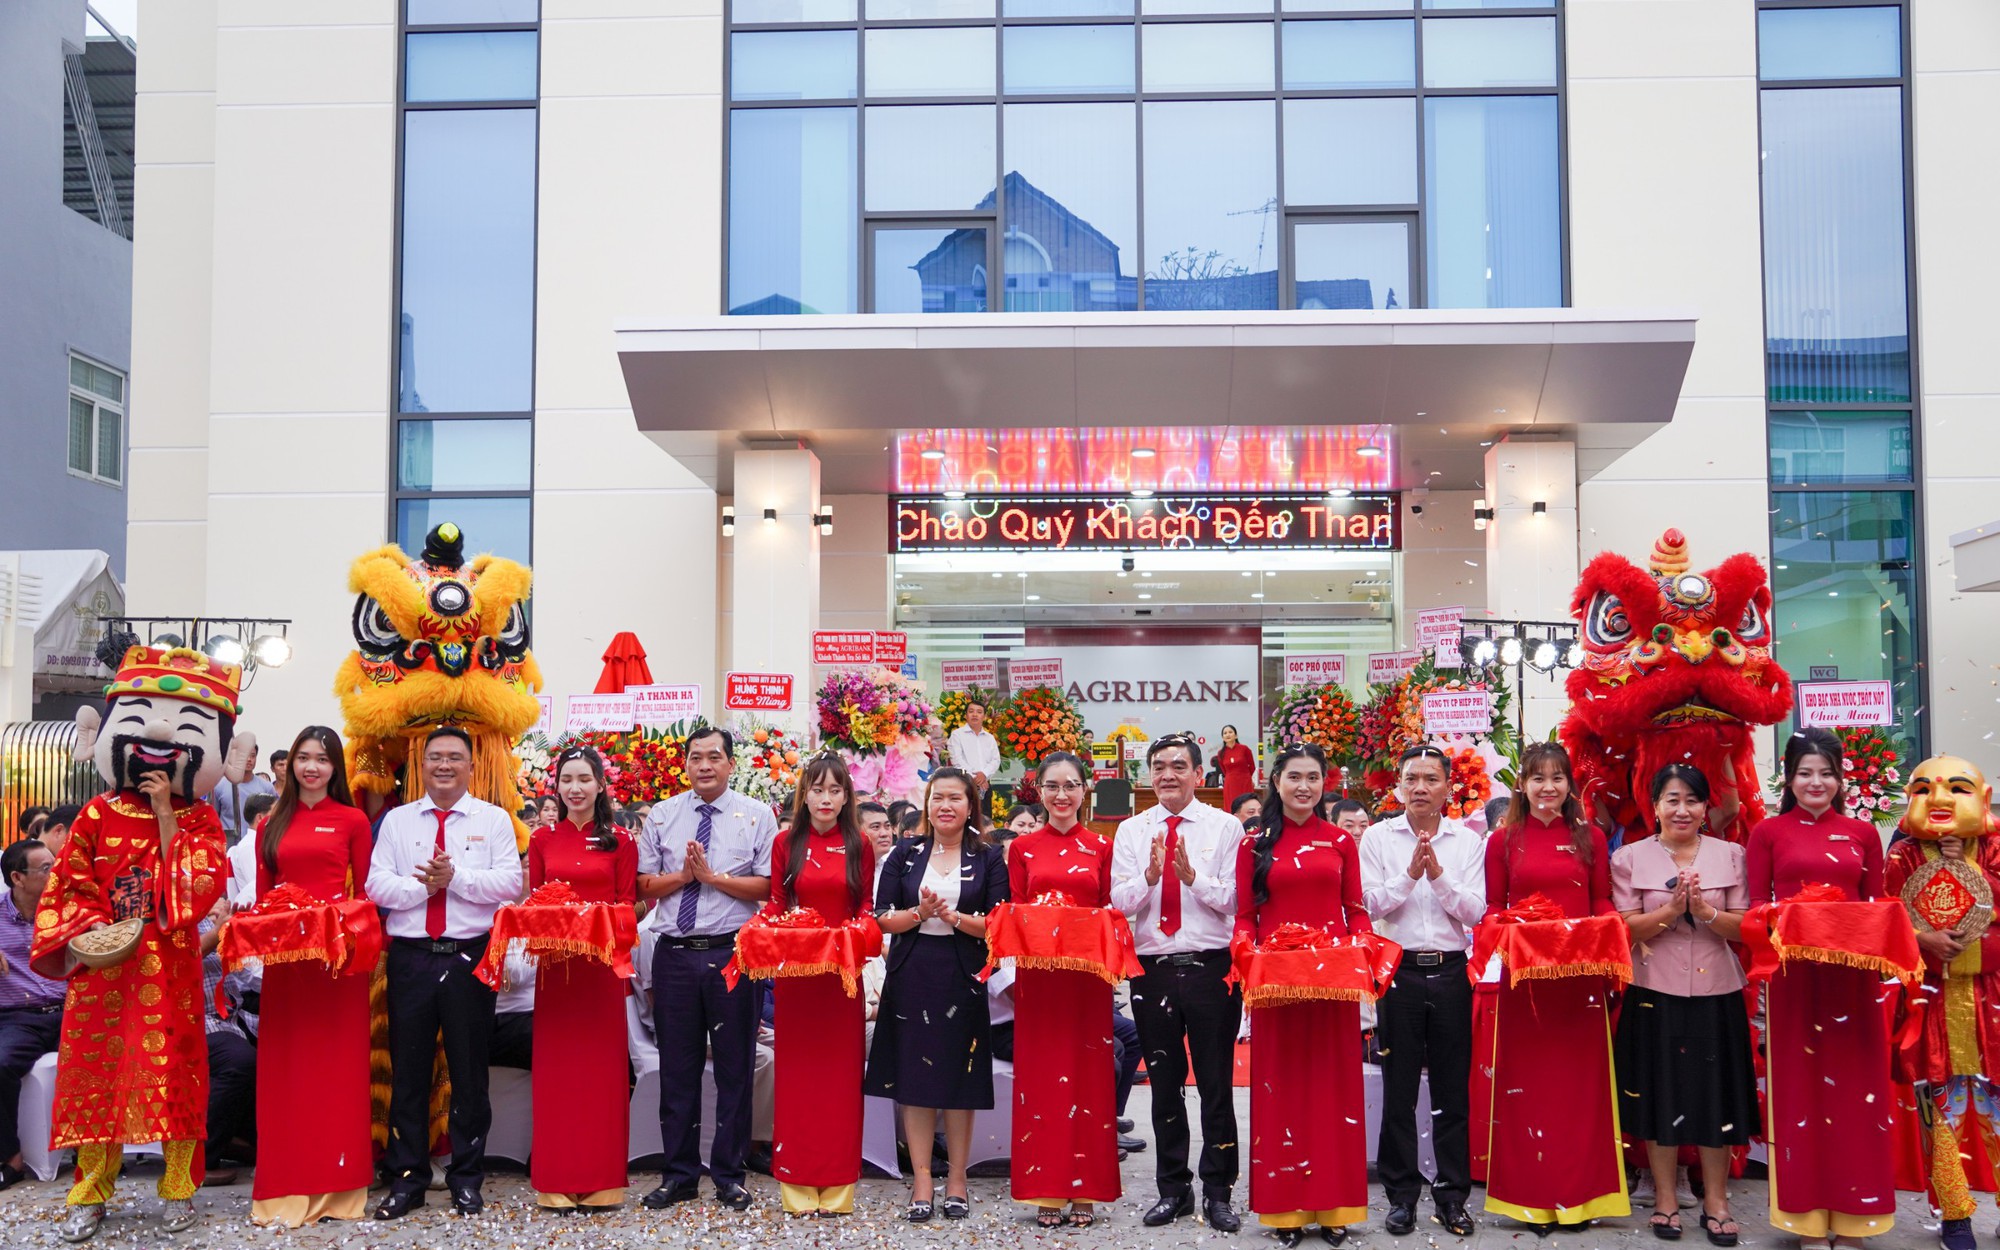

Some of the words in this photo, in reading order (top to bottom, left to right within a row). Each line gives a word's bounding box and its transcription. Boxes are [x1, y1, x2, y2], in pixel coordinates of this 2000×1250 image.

[1000, 508, 1075, 549] Quý
[1087, 508, 1200, 541] Khách
[1212, 500, 1287, 540] Đến
[840, 644, 872, 652] AGRIBANK
[1305, 658, 1320, 672] PHỐ
[1813, 668, 1835, 677] WC
[647, 691, 678, 701] THANH
[681, 688, 694, 700] HÀ
[760, 685, 784, 697] THỊNH
[1065, 680, 1250, 703] AGRIBANK
[730, 695, 754, 705] Chúc
[756, 696, 787, 709] Mừng
[1428, 698, 1442, 708] CÔNG
[1443, 698, 1449, 707] TY
[1451, 698, 1458, 707] CP
[1459, 697, 1471, 707] HIỆP
[1805, 692, 1817, 707] KHO
[1818, 692, 1829, 710] BẠC
[1842, 688, 1857, 706] NƯỚC
[1857, 687, 1872, 706] THỐT
[1872, 686, 1884, 705] NỐT
[1810, 710, 1840, 721] Chúc
[1844, 709, 1880, 721] Mừng
[569, 718, 593, 726] Chúc
[601, 717, 628, 728] Mừng
